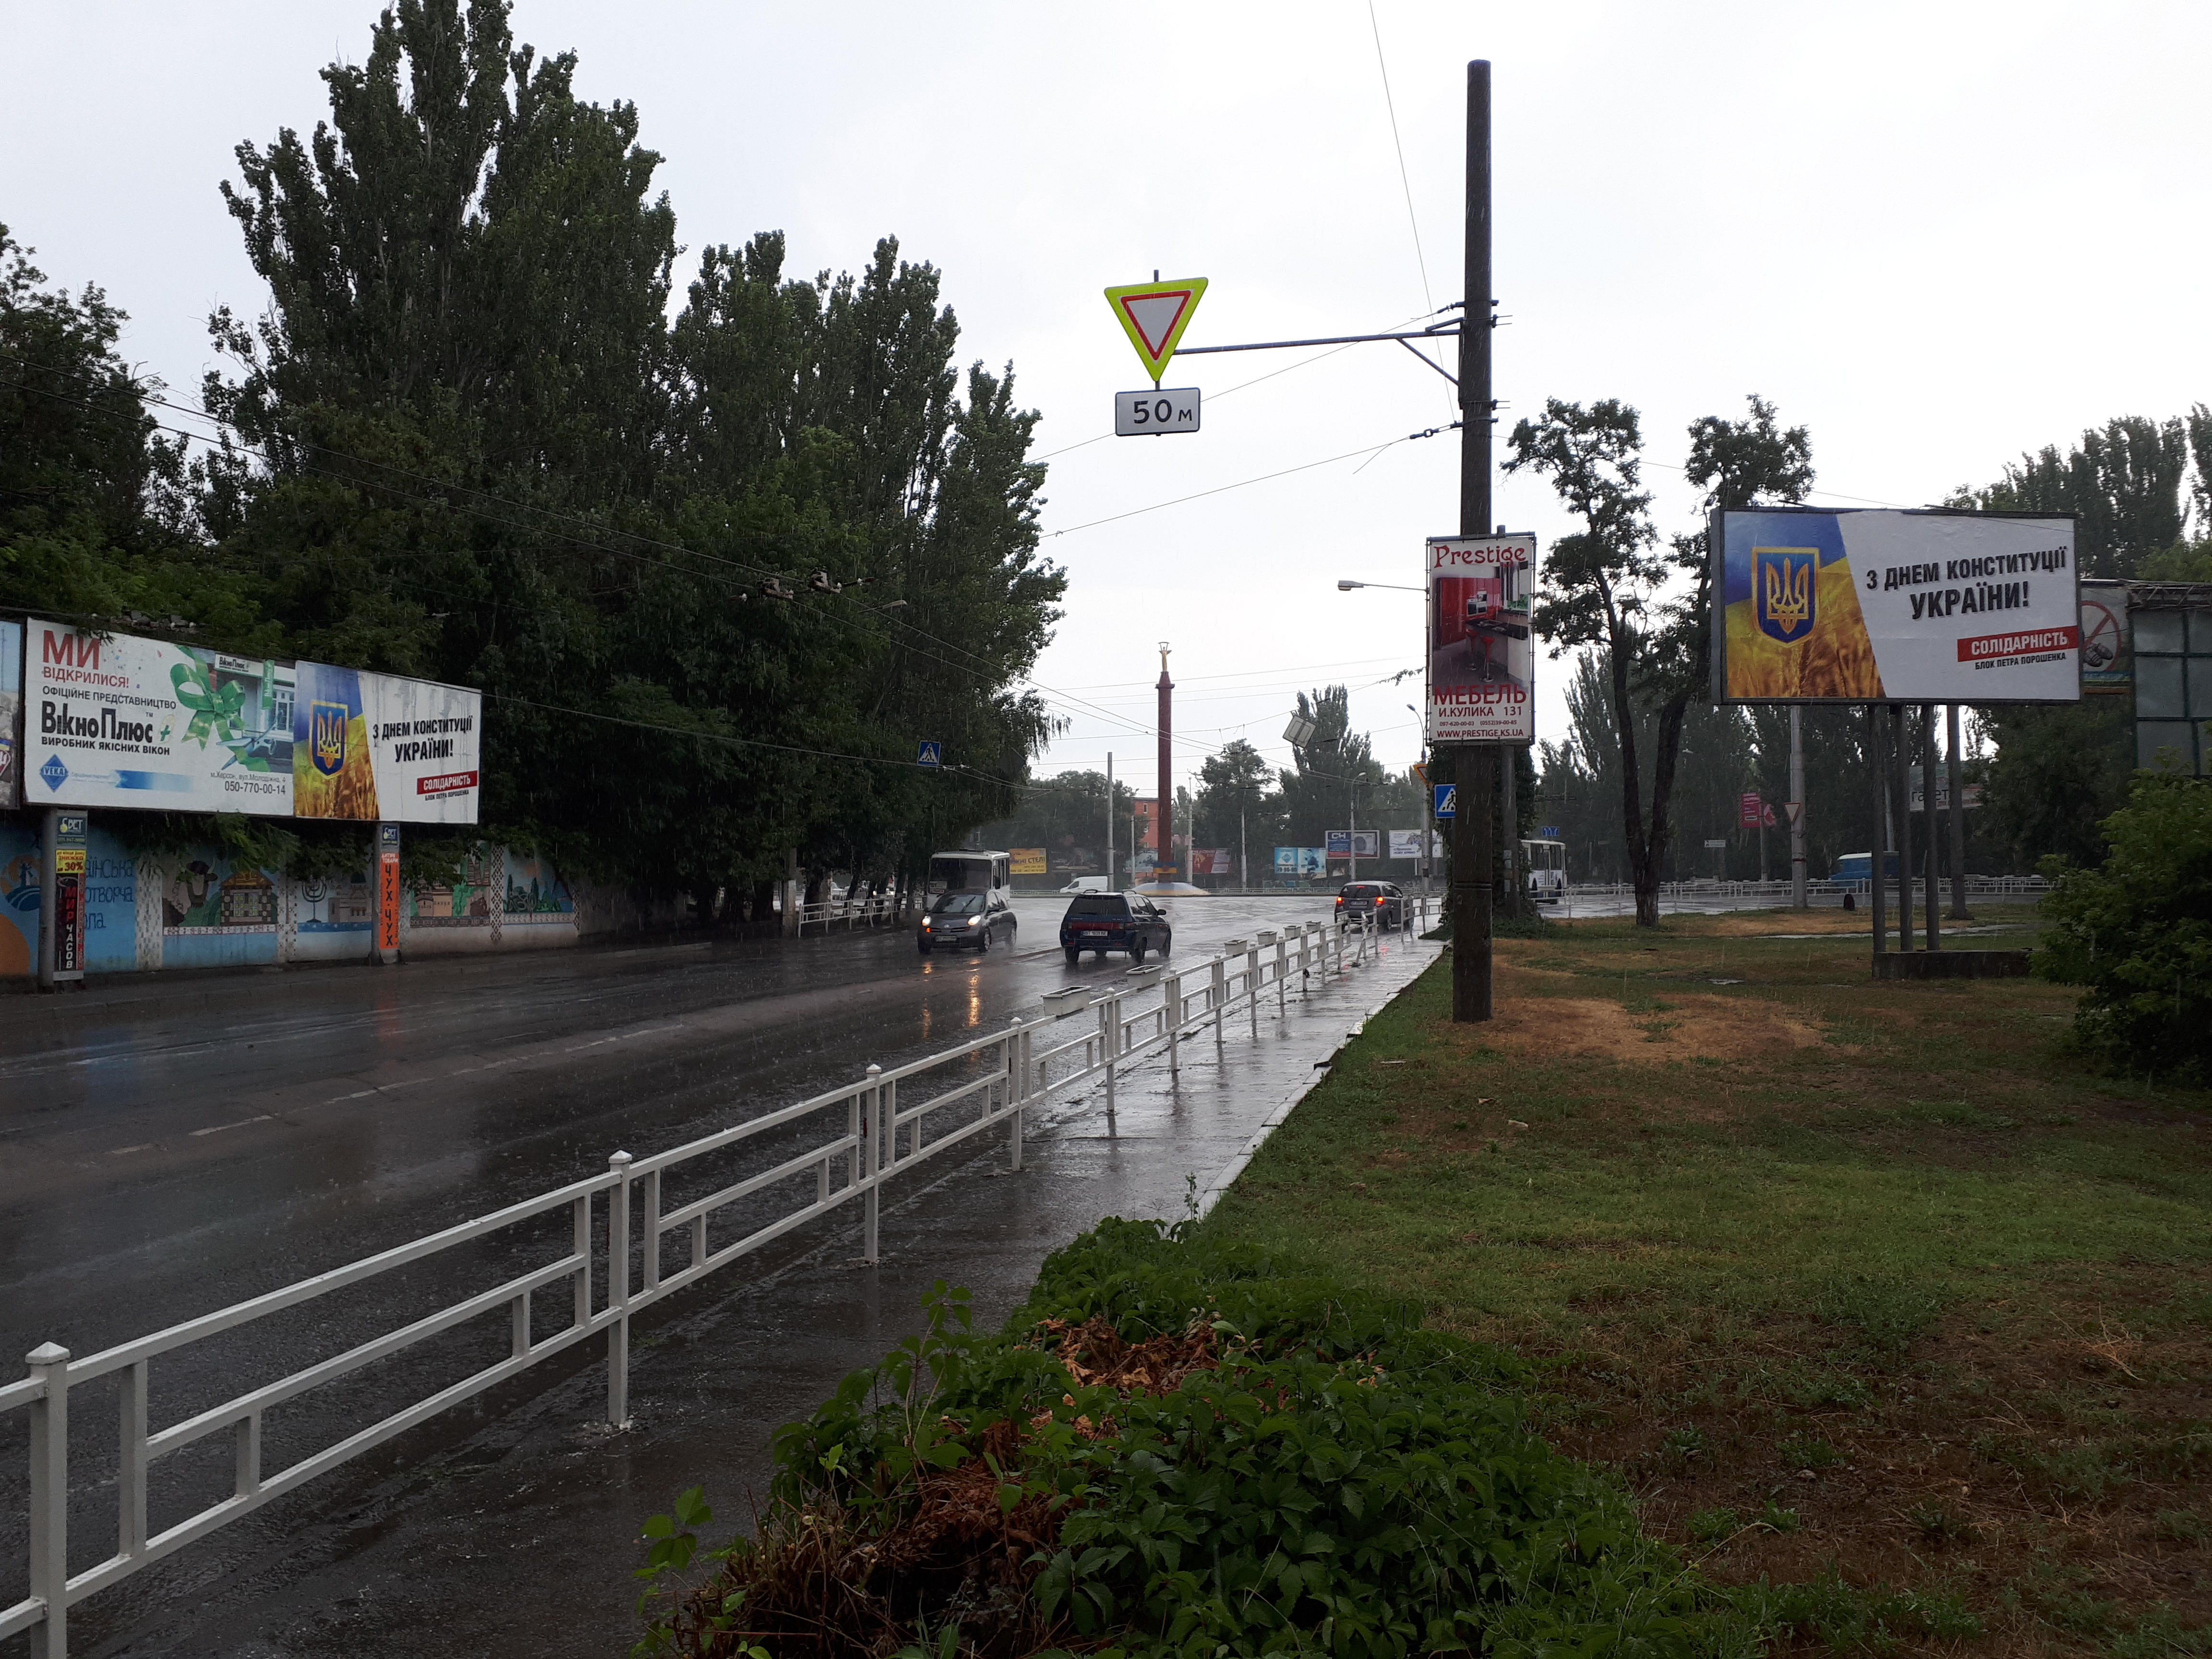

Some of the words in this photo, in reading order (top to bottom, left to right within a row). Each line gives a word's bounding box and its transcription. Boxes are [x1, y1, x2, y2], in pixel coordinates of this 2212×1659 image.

[1134, 399, 1172, 424] 50
[1433, 544, 1527, 568] Prestige
[1866, 569, 1877, 589] З
[1885, 562, 1939, 591] ДНЕМ
[1947, 545, 2067, 580] КОНСТИТУЦІЇ
[1910, 581, 2029, 620] УКРАЇНИ!
[43, 630, 100, 670] МИ
[1971, 631, 2068, 656] СОЛІДАРНІСТЬ
[1975, 661, 1996, 670] БЛОК
[1997, 657, 2019, 668] ПЕТРА
[2021, 652, 2067, 664] ПОРОШЕНКА
[43, 666, 130, 688] ВІДКРИЛИСЯ!
[43, 685, 90, 700] ОФІЦІЙНЕ
[93, 692, 176, 709] ПРЕДСТАВНИЦТВО
[1434, 684, 1527, 705] МЕБЕЛЬ
[1439, 706, 1494, 717] И.КУЛИКА
[1503, 706, 1521, 716] 131
[382, 722, 410, 740] ДНЕМ
[413, 715, 473, 735] КОНСТИТУЦІЇ
[1437, 729, 1524, 737] WWW.PRESTIGE.KS.UA
[41, 736, 96, 749] ВИРОБНИК
[98, 742, 140, 753] ЯКІСНИХ
[143, 746, 170, 755] ВІКОН
[395, 738, 453, 762] УКРАЇНИ!
[225, 781, 286, 794] 050-770-00-14
[423, 775, 470, 790] СОЛІДАРНІСТЬ
[65, 862, 83, 871] 30%
[65, 923, 73, 969] ЧАСОВ
